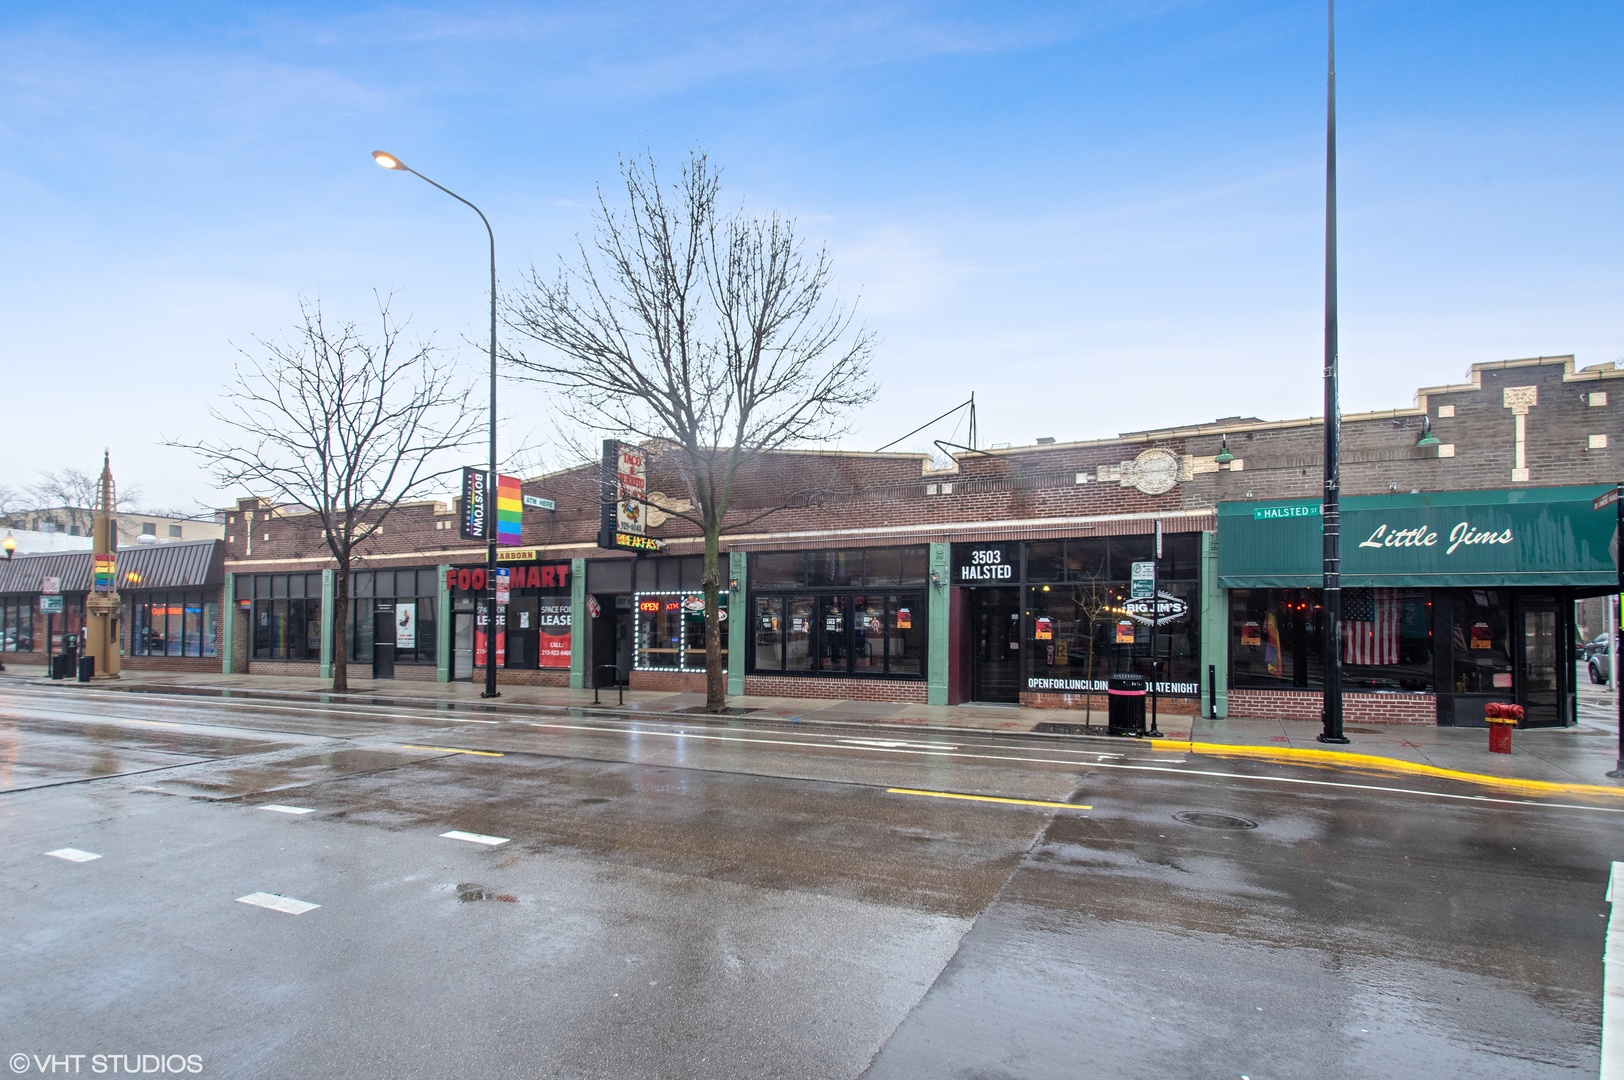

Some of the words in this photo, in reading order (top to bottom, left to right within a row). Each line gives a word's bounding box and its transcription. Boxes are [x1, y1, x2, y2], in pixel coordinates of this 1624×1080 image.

[623, 453, 642, 467] TACO
[628, 466, 636, 475] &
[473, 473, 484, 537] BOYSTOWN
[538, 499, 553, 508] HERE
[1264, 506, 1309, 518] HALSTED
[1358, 523, 1438, 548] Little
[1446, 521, 1514, 555] Jims
[498, 551, 534, 560] ARBORN
[971, 550, 1001, 564] 3503
[446, 567, 489, 591] FOO
[509, 565, 569, 588] MART
[961, 564, 1012, 580] HALSTED
[541, 605, 559, 613] SPACE
[640, 602, 660, 611] OPEN
[1126, 603, 1148, 612] BIG
[1149, 603, 1182, 612] JIM'S
[477, 615, 506, 626] LESE
[541, 615, 571, 626] LEASE
[1028, 677, 1049, 688] OPEN
[1049, 678, 1065, 689] FOR
[1171, 682, 1199, 694] NIGHT
